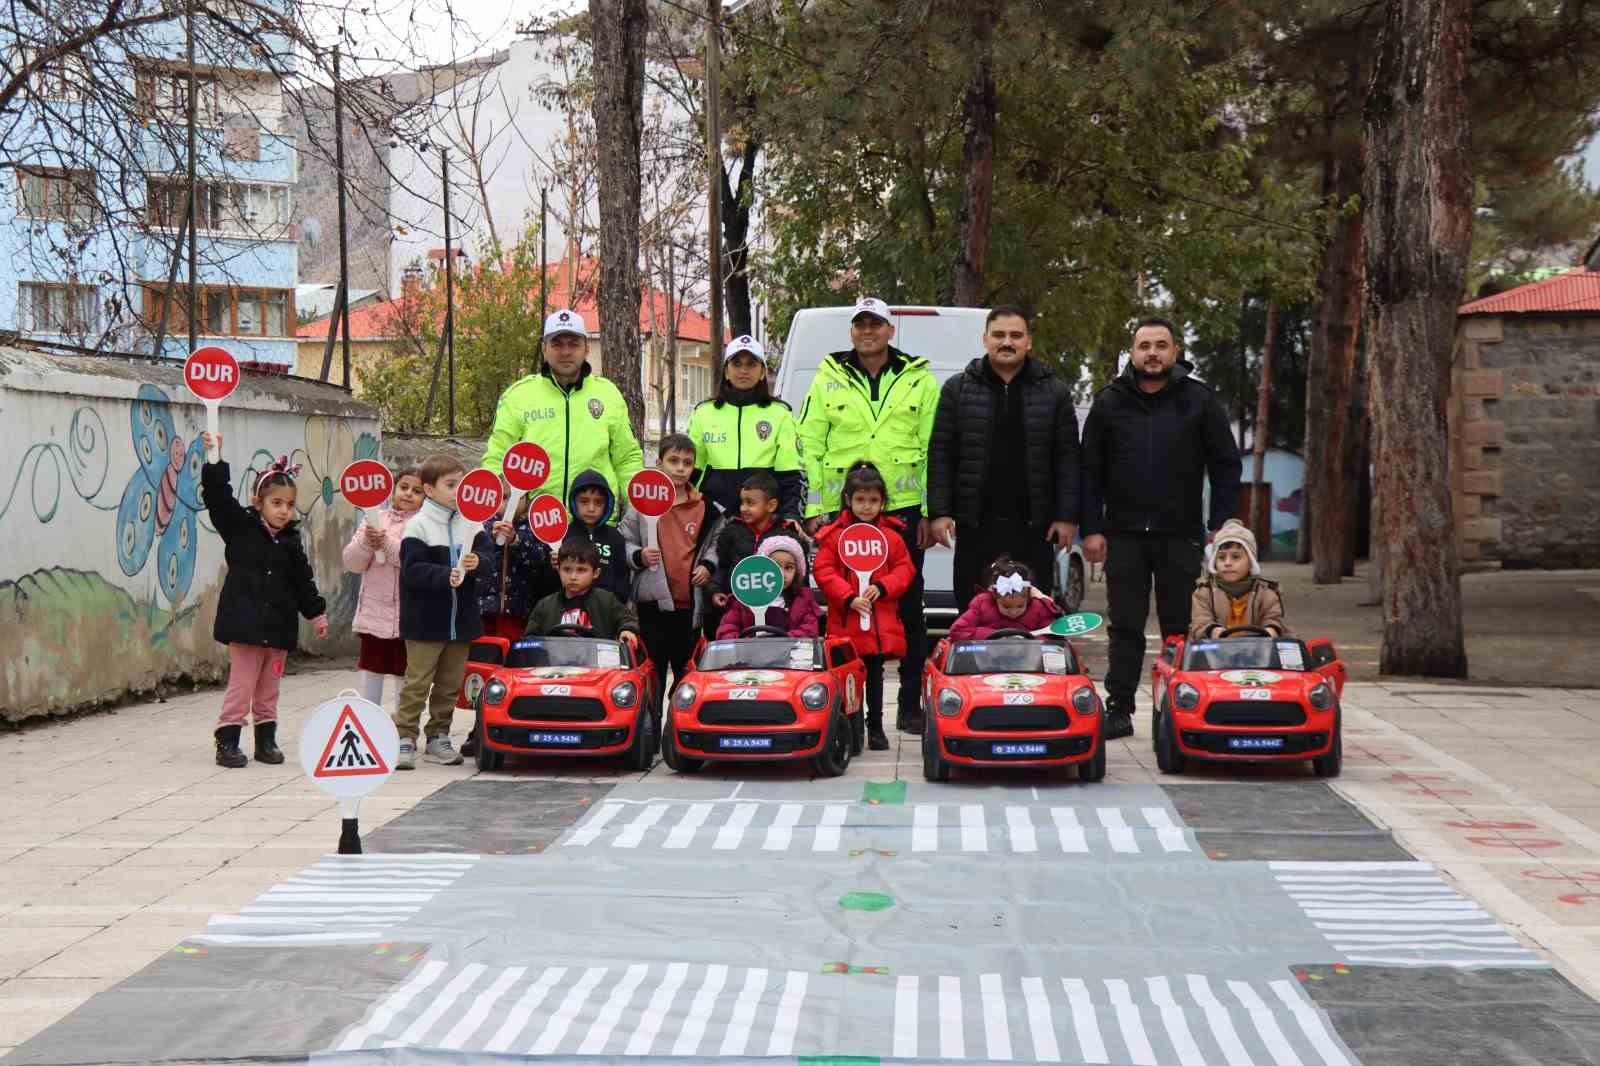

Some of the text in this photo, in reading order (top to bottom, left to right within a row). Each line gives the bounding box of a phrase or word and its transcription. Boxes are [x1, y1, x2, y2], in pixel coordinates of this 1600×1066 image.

[191, 362, 233, 383] DUR
[507, 452, 545, 478] DUR
[345, 474, 386, 493] DUR
[632, 483, 669, 501] DUR
[462, 484, 498, 508] DUR
[532, 508, 563, 529] DUR
[844, 539, 883, 557] DUR
[735, 571, 776, 593] GEÇ
